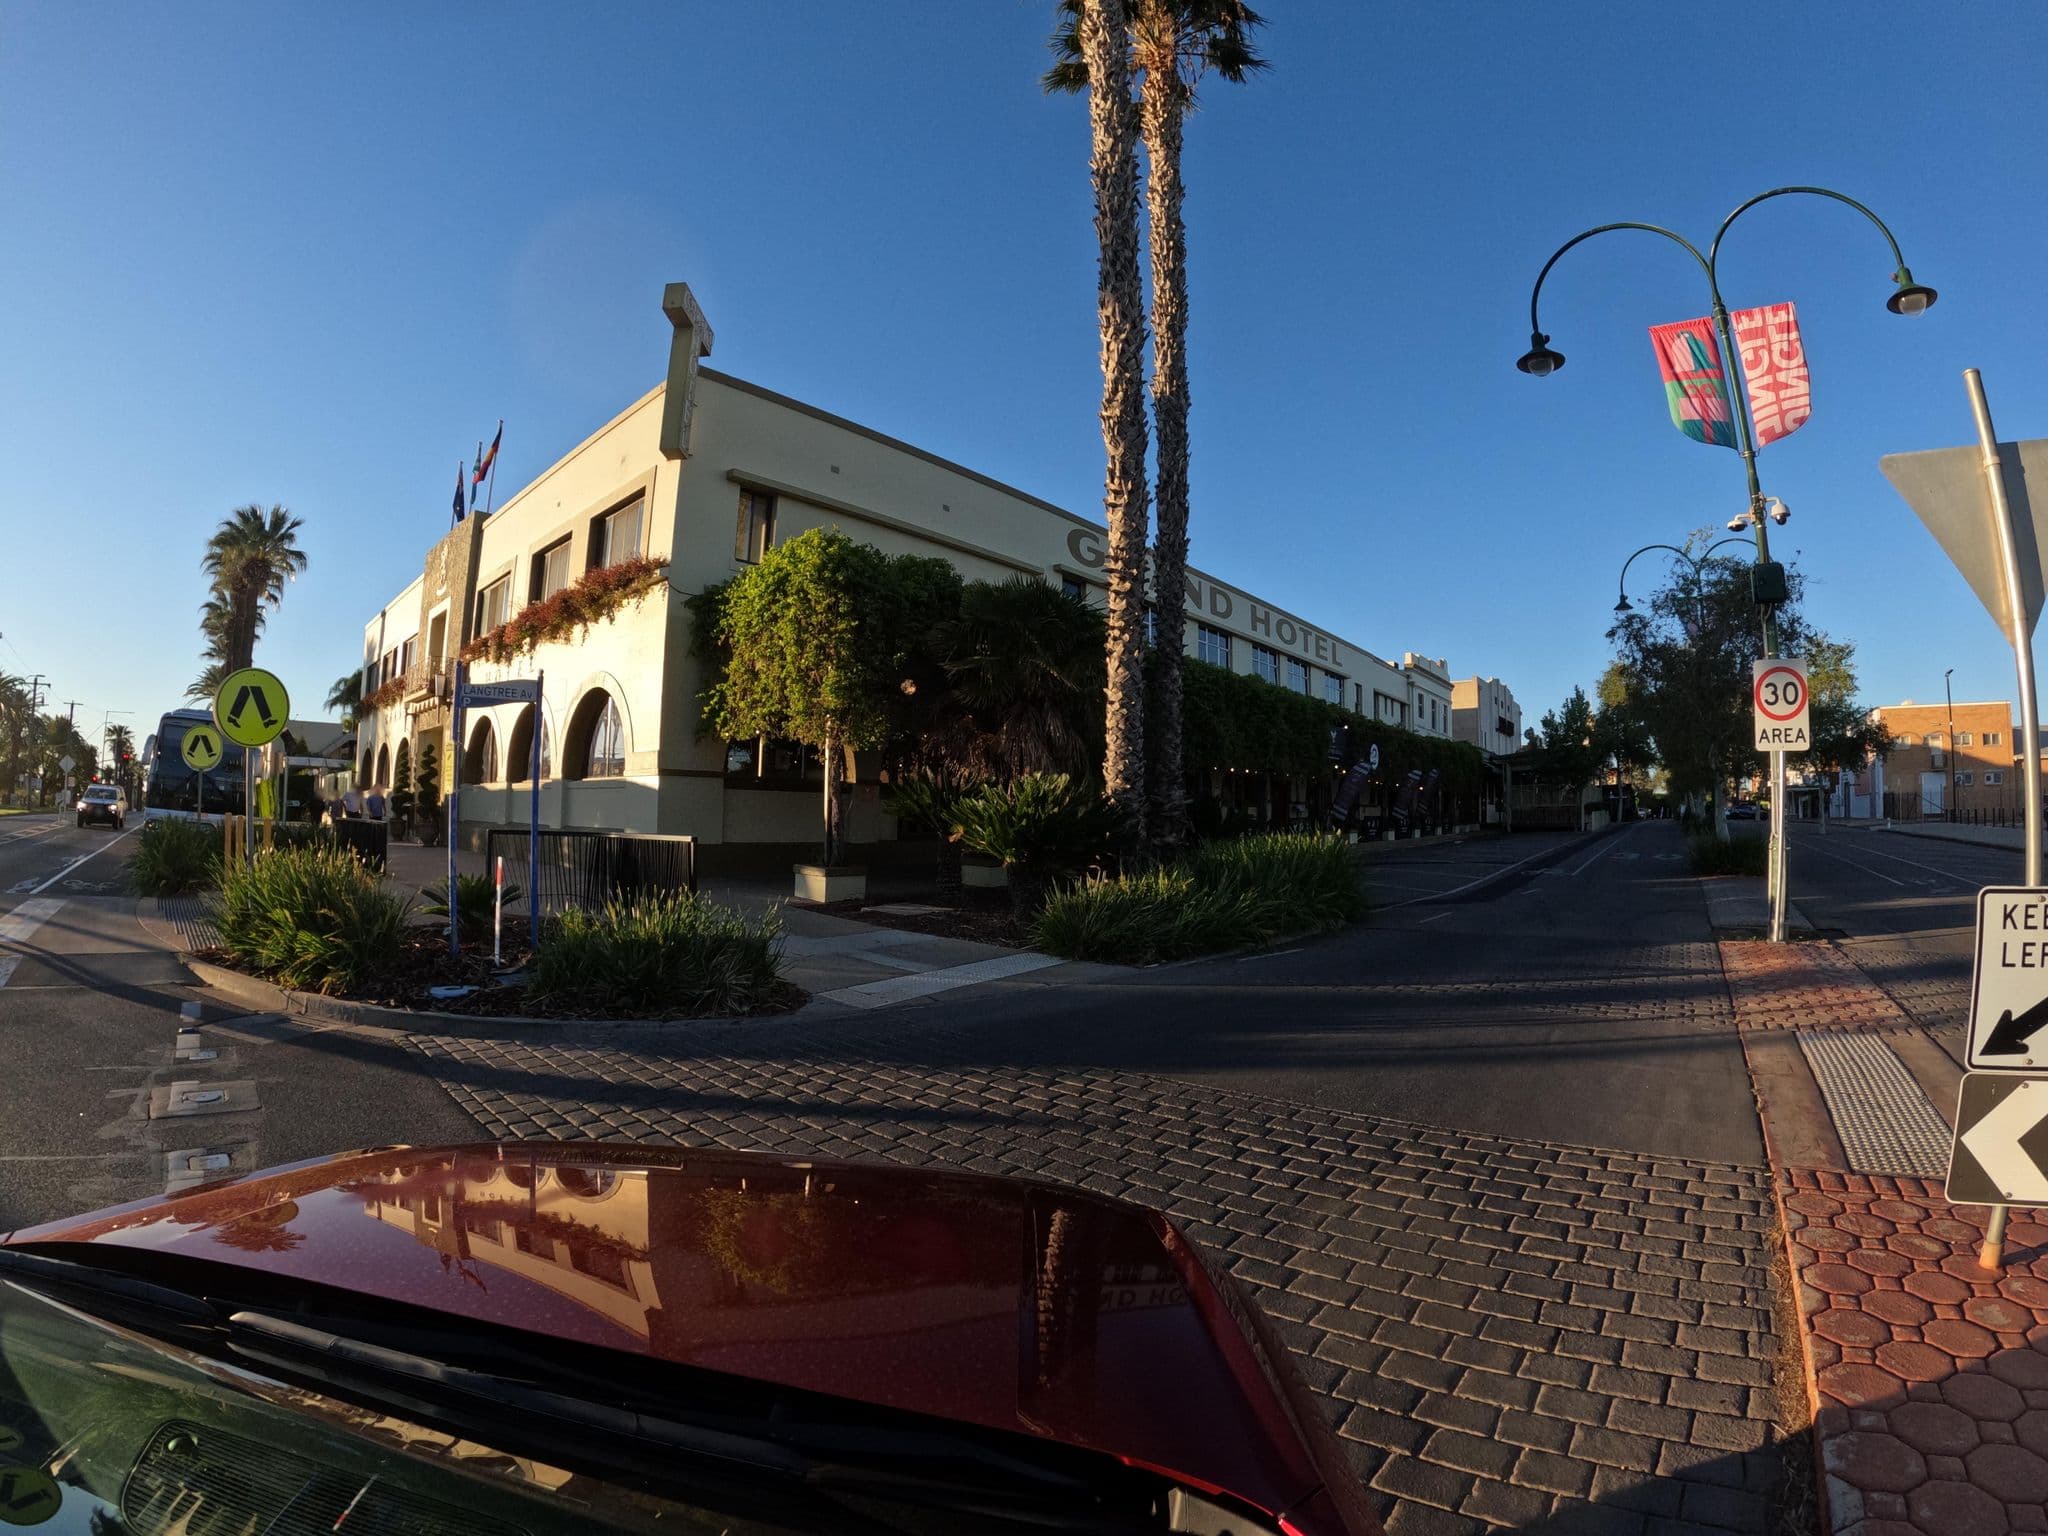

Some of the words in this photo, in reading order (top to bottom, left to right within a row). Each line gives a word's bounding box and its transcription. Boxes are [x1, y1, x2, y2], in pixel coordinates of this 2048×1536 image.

[1067, 528, 1232, 619] GND
[1251, 604, 1343, 667] HOTEL
[463, 686, 518, 698] LANGTREE
[1764, 682, 1798, 705] 30
[1759, 728, 1807, 743] AREA
